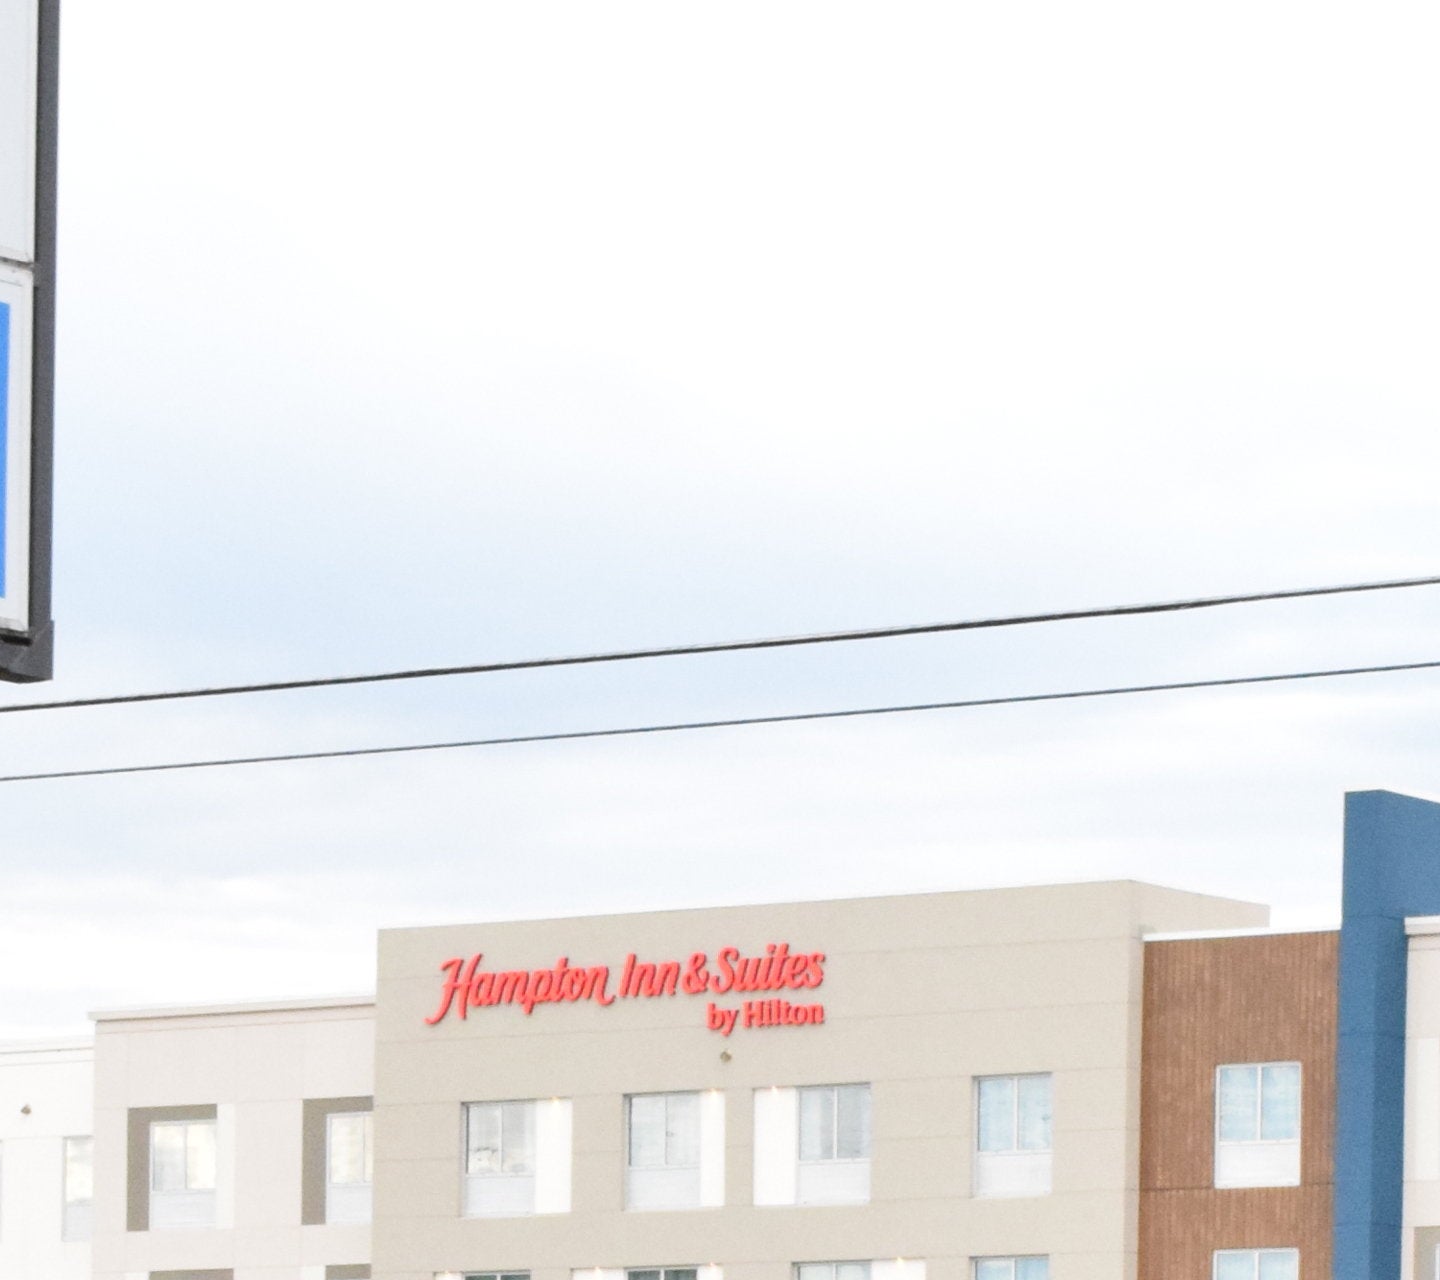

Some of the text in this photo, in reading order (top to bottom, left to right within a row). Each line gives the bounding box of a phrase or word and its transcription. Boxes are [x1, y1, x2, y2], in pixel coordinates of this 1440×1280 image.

[424, 953, 615, 1025] Hampton
[706, 998, 825, 1037] by Hilton
